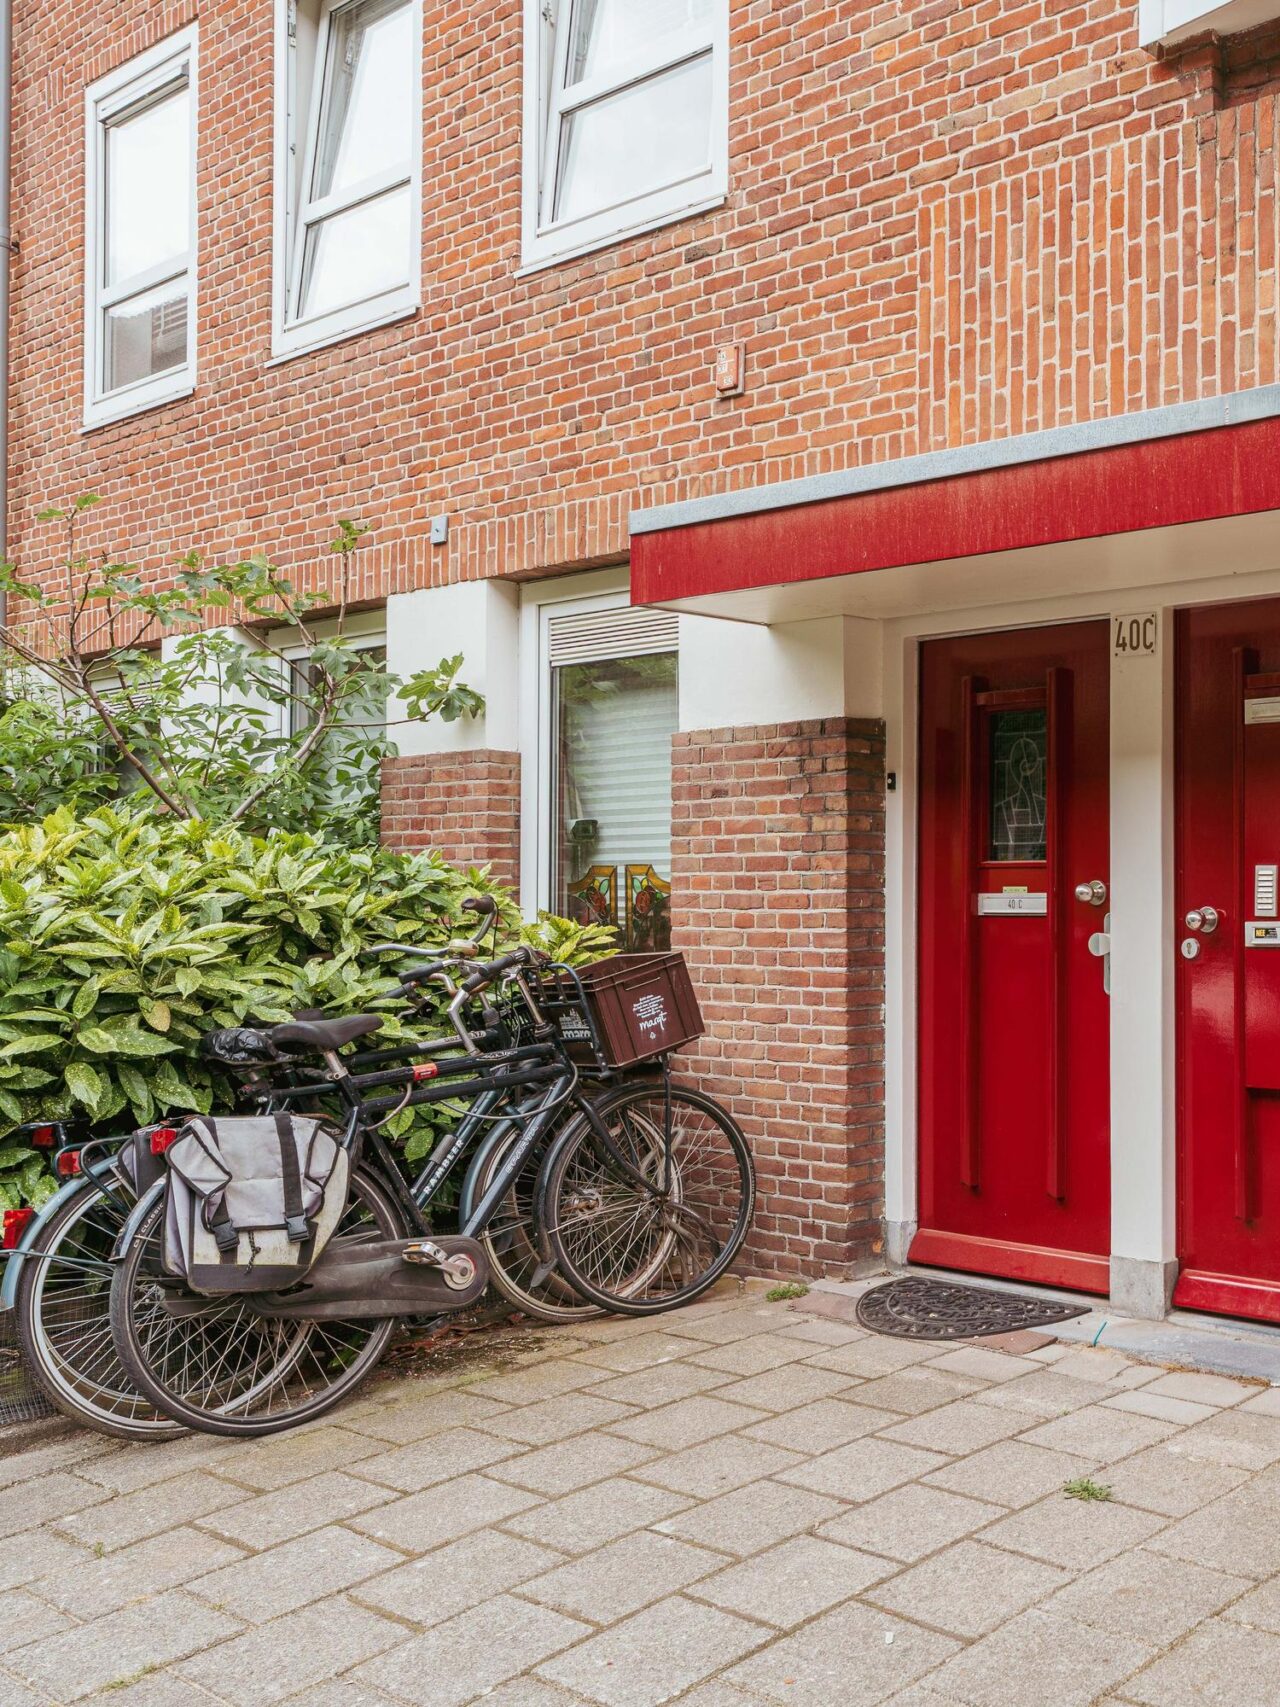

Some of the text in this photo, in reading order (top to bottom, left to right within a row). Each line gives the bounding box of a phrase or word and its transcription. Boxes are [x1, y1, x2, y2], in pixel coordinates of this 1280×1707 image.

[1115, 617, 1154, 652] 40C
[1007, 899, 1023, 909] 40 C
[1255, 929, 1265, 937] NEE
[423, 1139, 465, 1195] RAMBLER
[141, 1202, 164, 1233] CLASSIC
